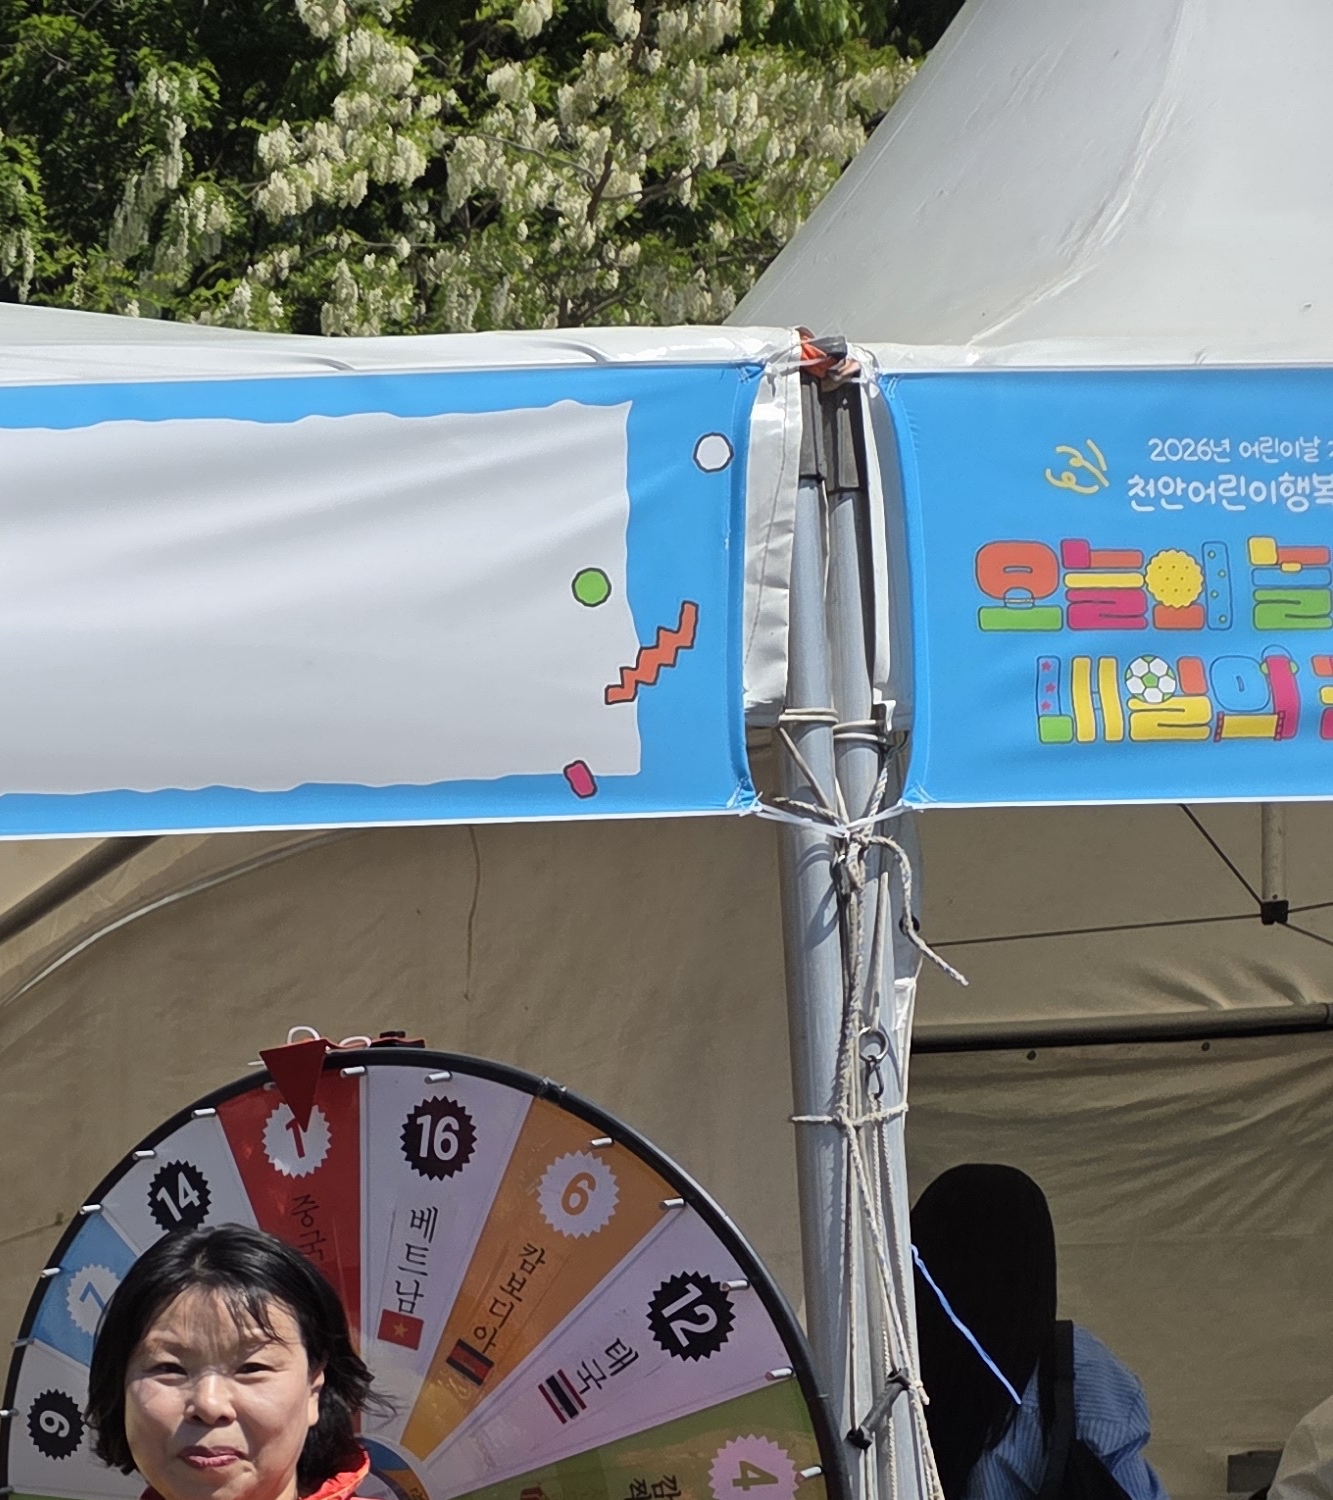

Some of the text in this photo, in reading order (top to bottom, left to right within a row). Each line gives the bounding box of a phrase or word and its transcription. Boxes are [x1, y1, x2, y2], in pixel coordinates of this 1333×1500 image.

[1147, 437, 1231, 463] 2026년
[1238, 435, 1322, 464] 어린이날
[1126, 471, 1333, 513] 천안어린이행복
[975, 537, 1233, 633] 오늘의
[1036, 646, 1301, 745] 내일의
[415, 1114, 460, 1162] 16
[155, 1170, 202, 1222] 14
[560, 1171, 597, 1217] 6
[290, 1193, 328, 1262] 중국
[394, 1205, 439, 1316] 베트남
[472, 1242, 547, 1355] 캄보디아
[660, 1281, 719, 1348] 12
[576, 1337, 640, 1396] 태국
[39, 1409, 71, 1438] 9
[731, 1459, 780, 1492] 4
